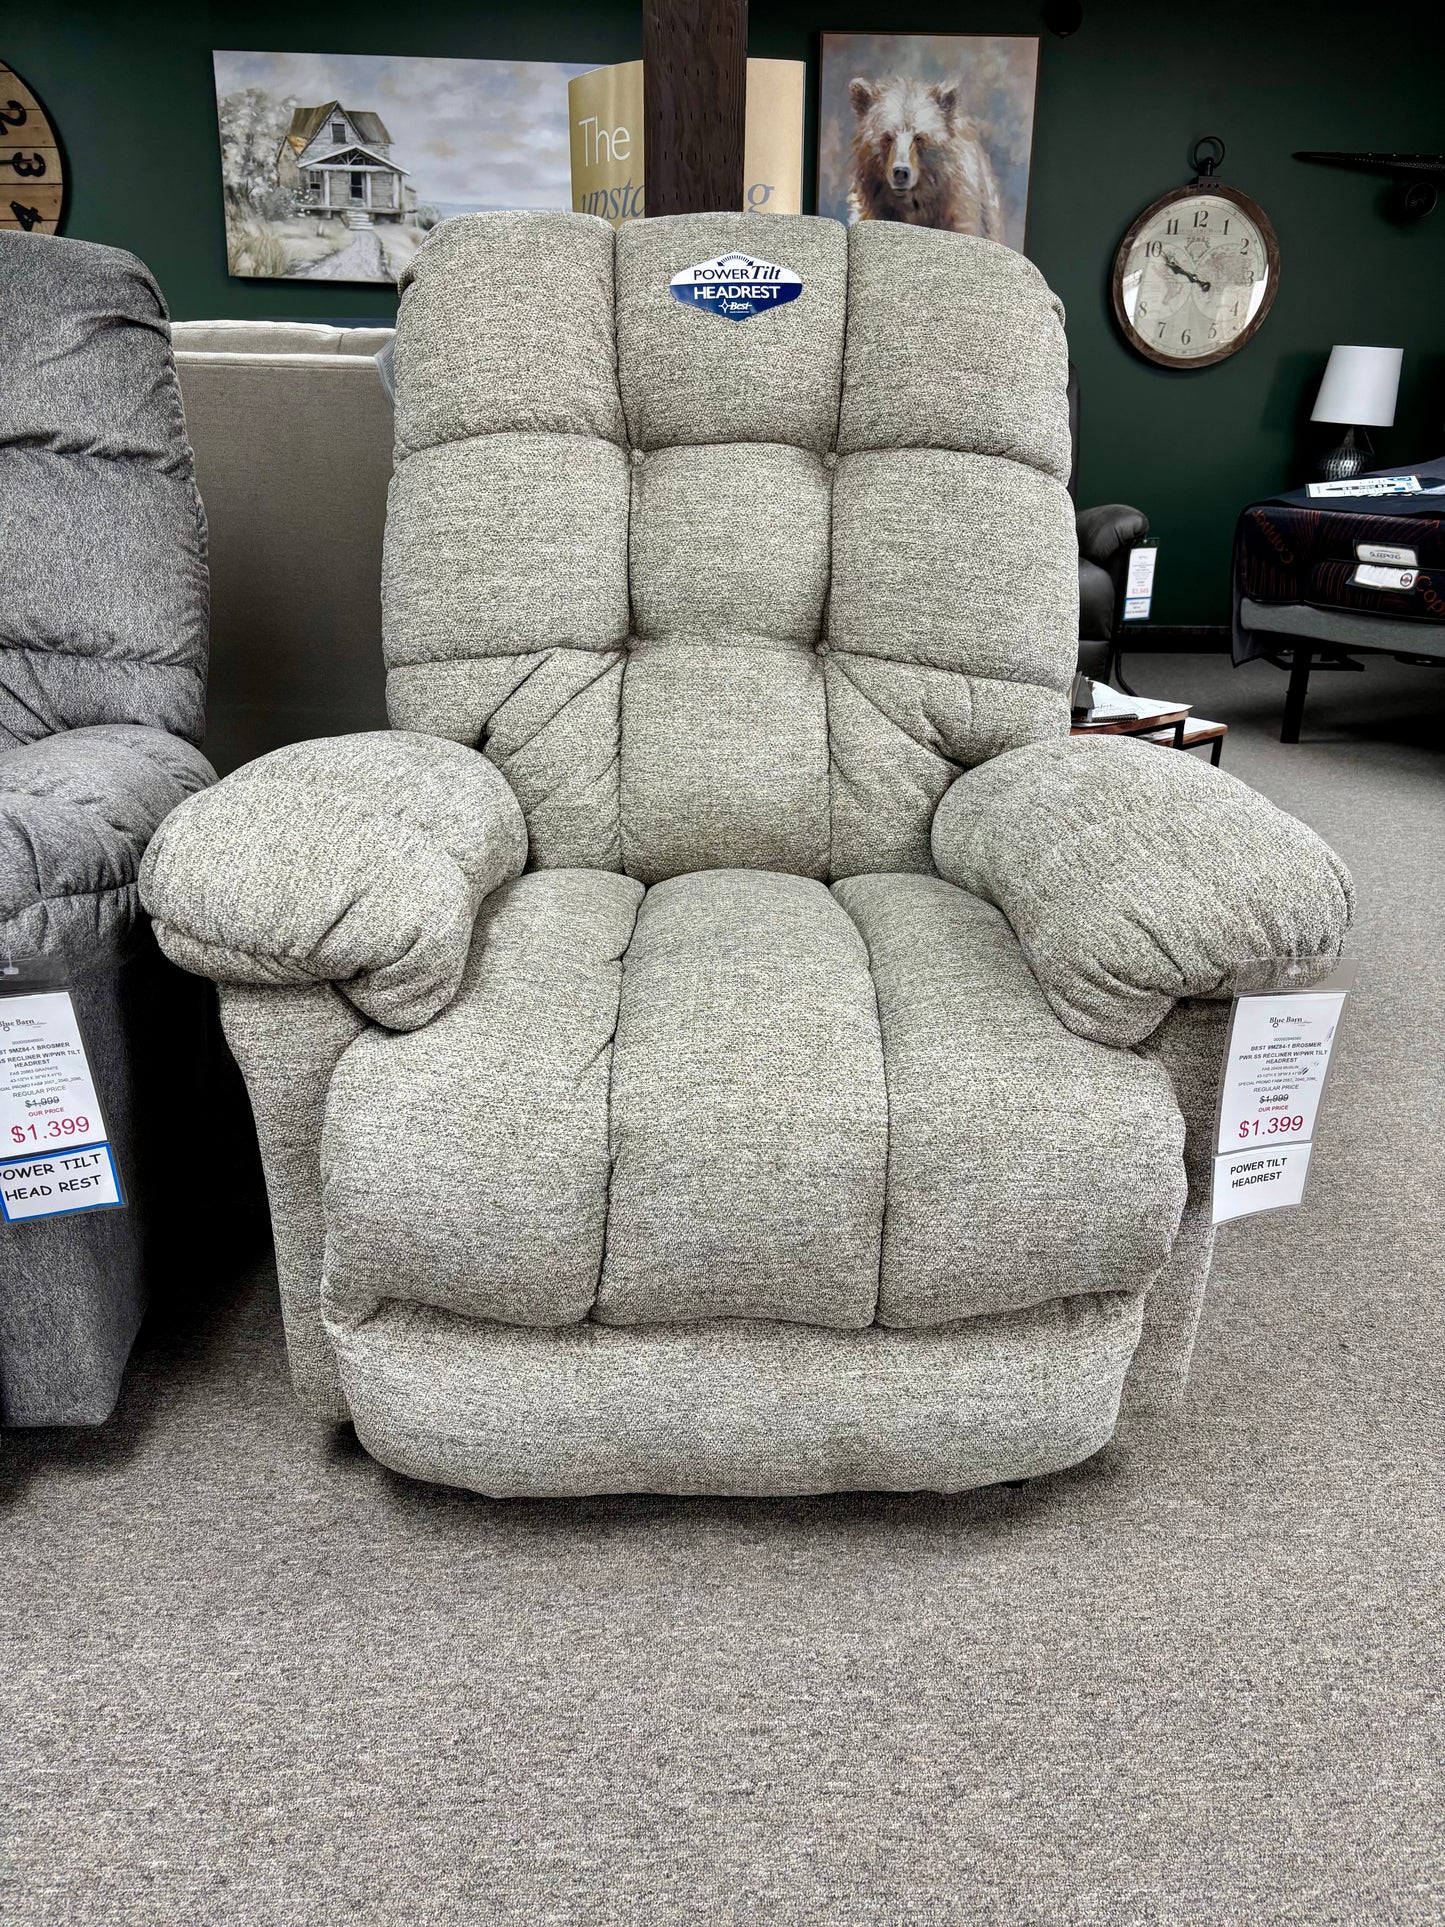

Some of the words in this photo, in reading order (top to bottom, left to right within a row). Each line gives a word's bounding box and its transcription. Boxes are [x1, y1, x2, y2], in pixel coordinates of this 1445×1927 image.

[578, 115, 631, 167] The
[12, 152, 46, 177] 3
[10, 200, 43, 232] 4
[1193, 210, 1209, 228] 12
[1166, 219, 1180, 235] 11
[1223, 219, 1231, 235] 1
[1145, 240, 1162, 257] 10
[1240, 238, 1250, 255] 2
[693, 268, 750, 280] POWER
[751, 265, 782, 280] Tilt
[1244, 270, 1254, 287] 3
[693, 286, 781, 300] HEADREST
[729, 301, 750, 311] Best
[1137, 301, 1148, 318] 8
[1229, 300, 1240, 317] 4
[1157, 321, 1167, 338] 7
[1181, 329, 1192, 345] 6
[1207, 322, 1218, 339] 5
[15, 1018, 35, 1026] Barn
[36, 1042, 70, 1050] BROSMER
[7, 1053, 41, 1062] RECLINER
[14, 1059, 50, 1068] HEADREST
[12, 1088, 45, 1098] REGULAR
[46, 1085, 67, 1093] PRICE
[28, 1109, 43, 1117] OUR
[44, 1107, 65, 1115] PRICE
[11, 1115, 90, 1144] $1.399
[1238, 1115, 1304, 1138] $1.399
[0, 1163, 55, 1180] OWER
[59, 1153, 101, 1170] TILT
[1230, 1160, 1265, 1175] POWER
[1266, 1157, 1288, 1168] TILT
[5, 1185, 52, 1201] HEAD
[58, 1174, 101, 1192] REST
[1231, 1171, 1282, 1189] HEADREST
